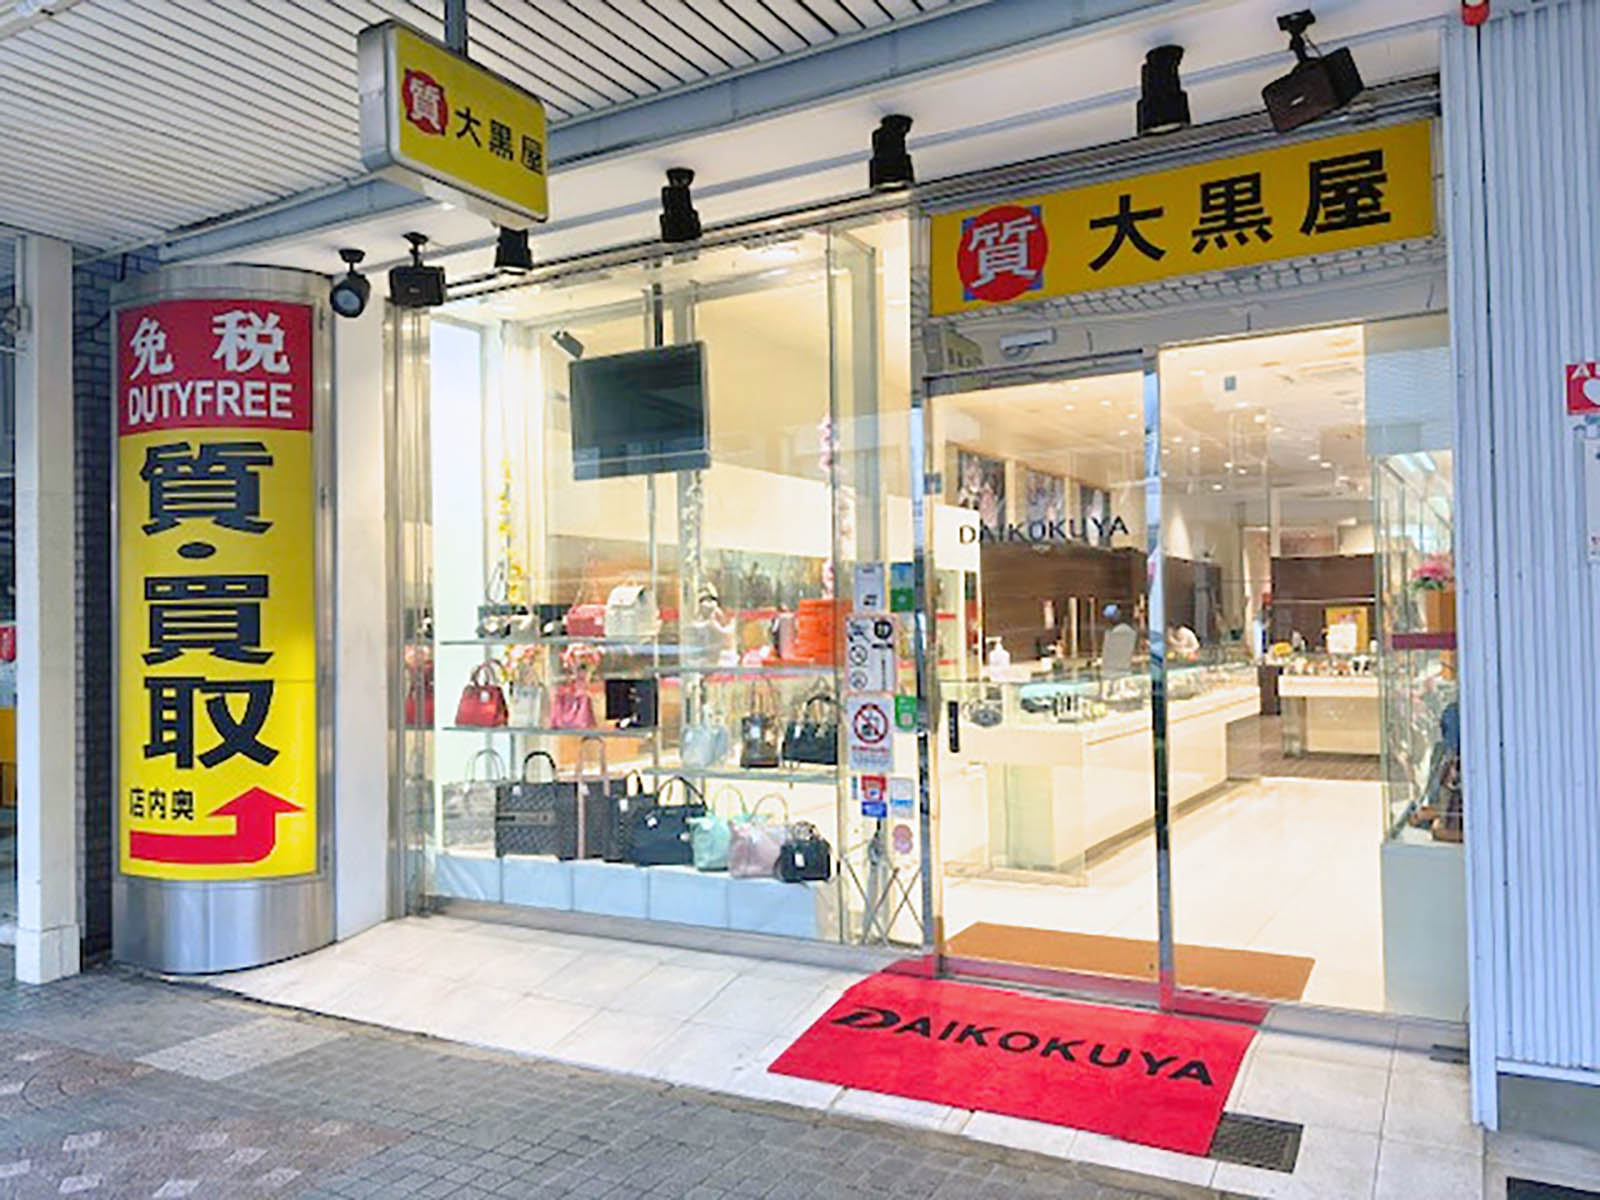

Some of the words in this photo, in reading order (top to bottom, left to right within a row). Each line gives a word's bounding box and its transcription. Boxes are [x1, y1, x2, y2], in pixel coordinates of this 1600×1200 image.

[410, 77, 441, 131] 質
[454, 107, 543, 176] 大黒屋
[967, 215, 1037, 287] 質
[1089, 149, 1392, 272] 大黒屋
[128, 380, 293, 425] DUTYFREE
[959, 515, 1129, 544] DAIKOKUYA
[831, 1006, 1213, 1086] DAIKOKUYA
